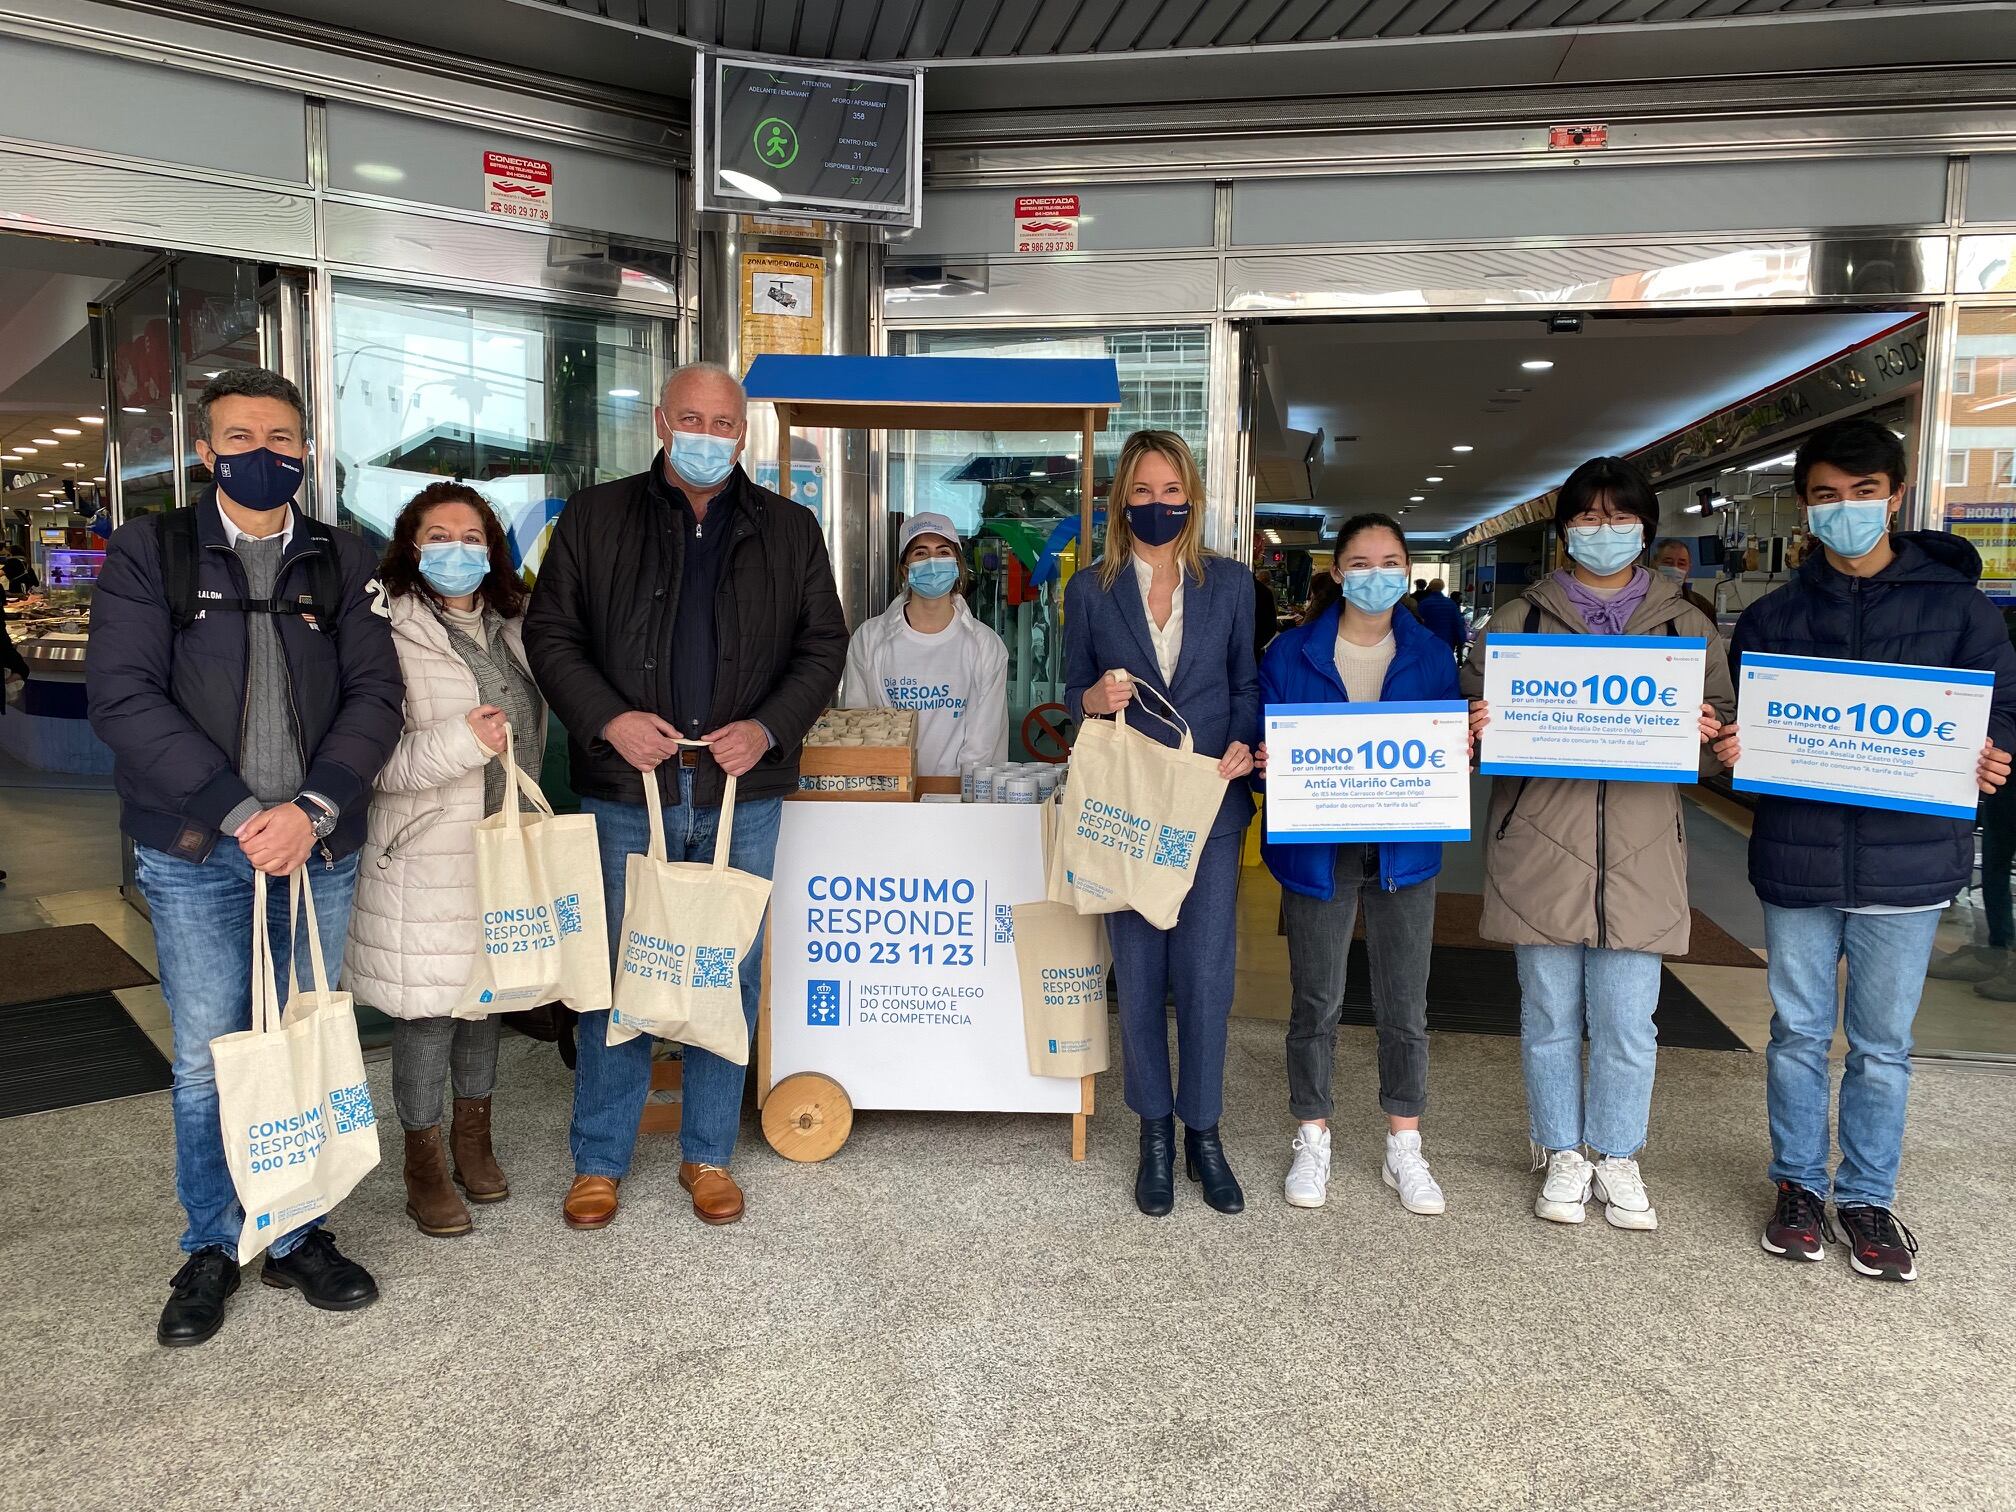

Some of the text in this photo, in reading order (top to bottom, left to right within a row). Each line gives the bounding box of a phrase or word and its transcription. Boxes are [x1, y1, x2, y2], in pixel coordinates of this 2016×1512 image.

[748, 86, 777, 95] ADELANTE
[781, 89, 810, 98] ENDAVANT
[801, 80, 831, 89] ATTENTION
[831, 97, 887, 108] AFORO AFORAMENT
[852, 112, 865, 120] 358
[838, 138, 878, 148] DENTRO DINS
[489, 154, 547, 170] CONECTADA
[824, 162, 889, 174] DISPONIBLE DISPONIBLE
[851, 177, 863, 185] 327
[504, 204, 548, 220] 986 29 37 39
[1032, 242, 1074, 251] 986 29 37 39
[747, 258, 819, 270] ZONA VIDEOVIGILADA
[1966, 508, 2016, 518] HORARI
[900, 676, 917, 686] das
[886, 685, 949, 700] PERSOAS
[1511, 674, 1678, 707] BONO 100€
[890, 698, 968, 711] ONSUMIDORA
[1536, 697, 1565, 705] importe
[1504, 710, 1680, 726] Mencía Qiu Rosende Vieitez
[1768, 701, 1957, 741] BONO 100€
[1794, 720, 1827, 730] importe
[1532, 735, 1560, 744] gañadora
[1788, 733, 1925, 758] Hugo Anh Meneses
[1291, 739, 1446, 769] BONO 100€
[1867, 755, 1891, 763] Castro
[1892, 757, 1913, 766] (Vigo)
[1315, 764, 1342, 772] importe
[1791, 758, 1818, 768] gañador
[1830, 763, 1861, 771] concurso
[1872, 766, 1891, 774] tarifa
[1304, 777, 1431, 789] Antía Vilariño Camba
[1084, 798, 1151, 831] CONSUMO
[1080, 812, 1148, 846] RESPONDE
[1077, 826, 1145, 859] 900 23 11 23
[808, 875, 975, 904] CONSUMO
[484, 905, 547, 925] CONSUO
[808, 908, 974, 937] RESPONDE
[486, 936, 556, 954] 900 23 23
[629, 930, 685, 957] CONSUMO
[626, 945, 683, 972] RESPONDE
[807, 941, 974, 966] 900 23 11 23
[640, 966, 652, 978] 23
[656, 970, 667, 981] 11
[670, 973, 681, 986] 23
[1041, 964, 1101, 979] CONSUMO
[860, 985, 984, 998] INSTITUTO GALEGO
[1043, 976, 1102, 993] RESPONDE
[860, 998, 957, 1011] DO CONSUMO E
[1045, 990, 1103, 1005] 900 23 11 23
[860, 1012, 972, 1024] DA COMPETENCIA
[251, 1156, 283, 1174] 900
[288, 1151, 306, 1165] 23
